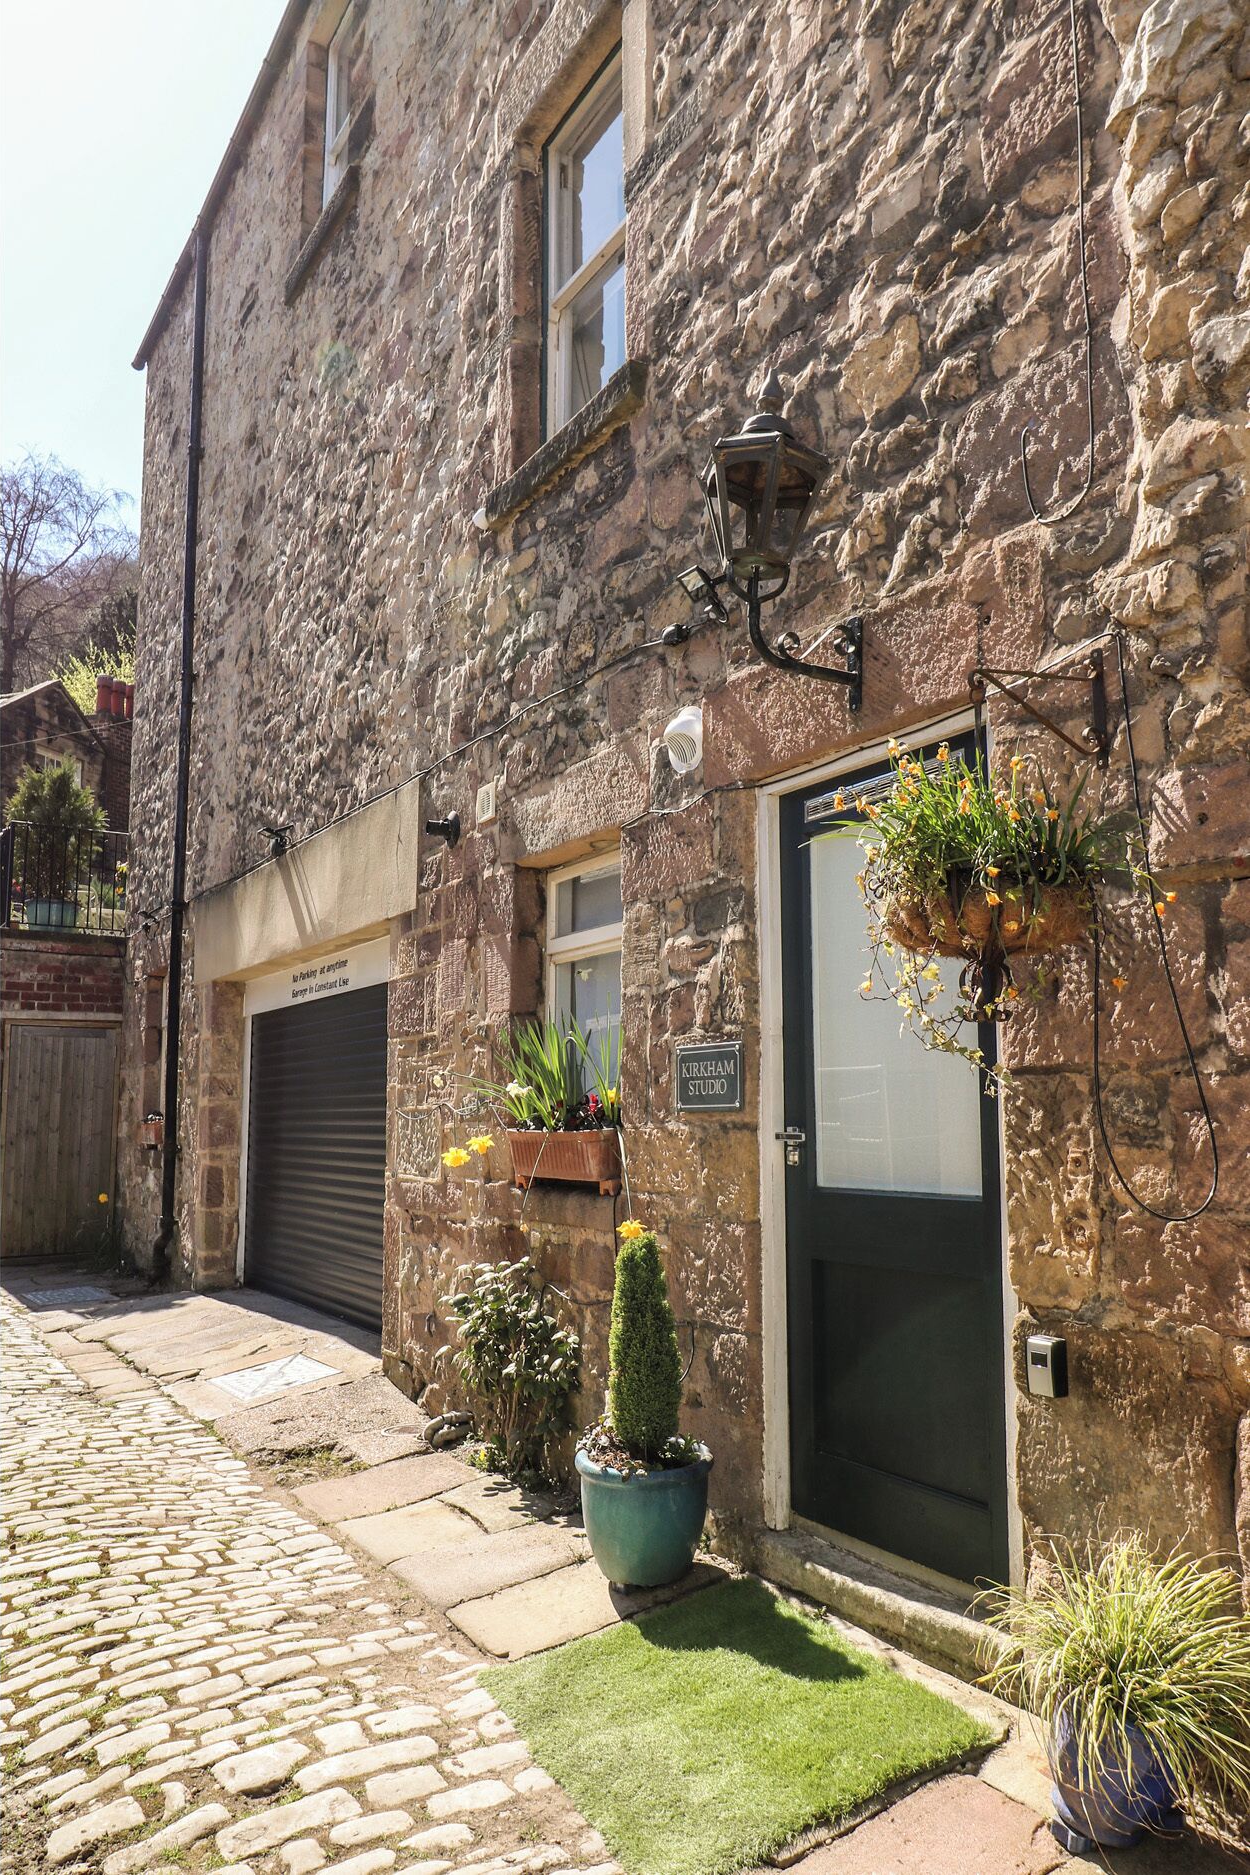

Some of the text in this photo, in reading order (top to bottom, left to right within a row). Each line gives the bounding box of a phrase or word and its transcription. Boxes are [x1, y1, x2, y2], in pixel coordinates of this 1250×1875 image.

[292, 959, 348, 983] No Parking at anytime
[292, 988, 308, 998] Garage
[314, 979, 337, 992] Constant
[338, 977, 349, 987] Use
[682, 1060, 734, 1077] KIRKHAM
[688, 1079, 727, 1095] STUDIO
